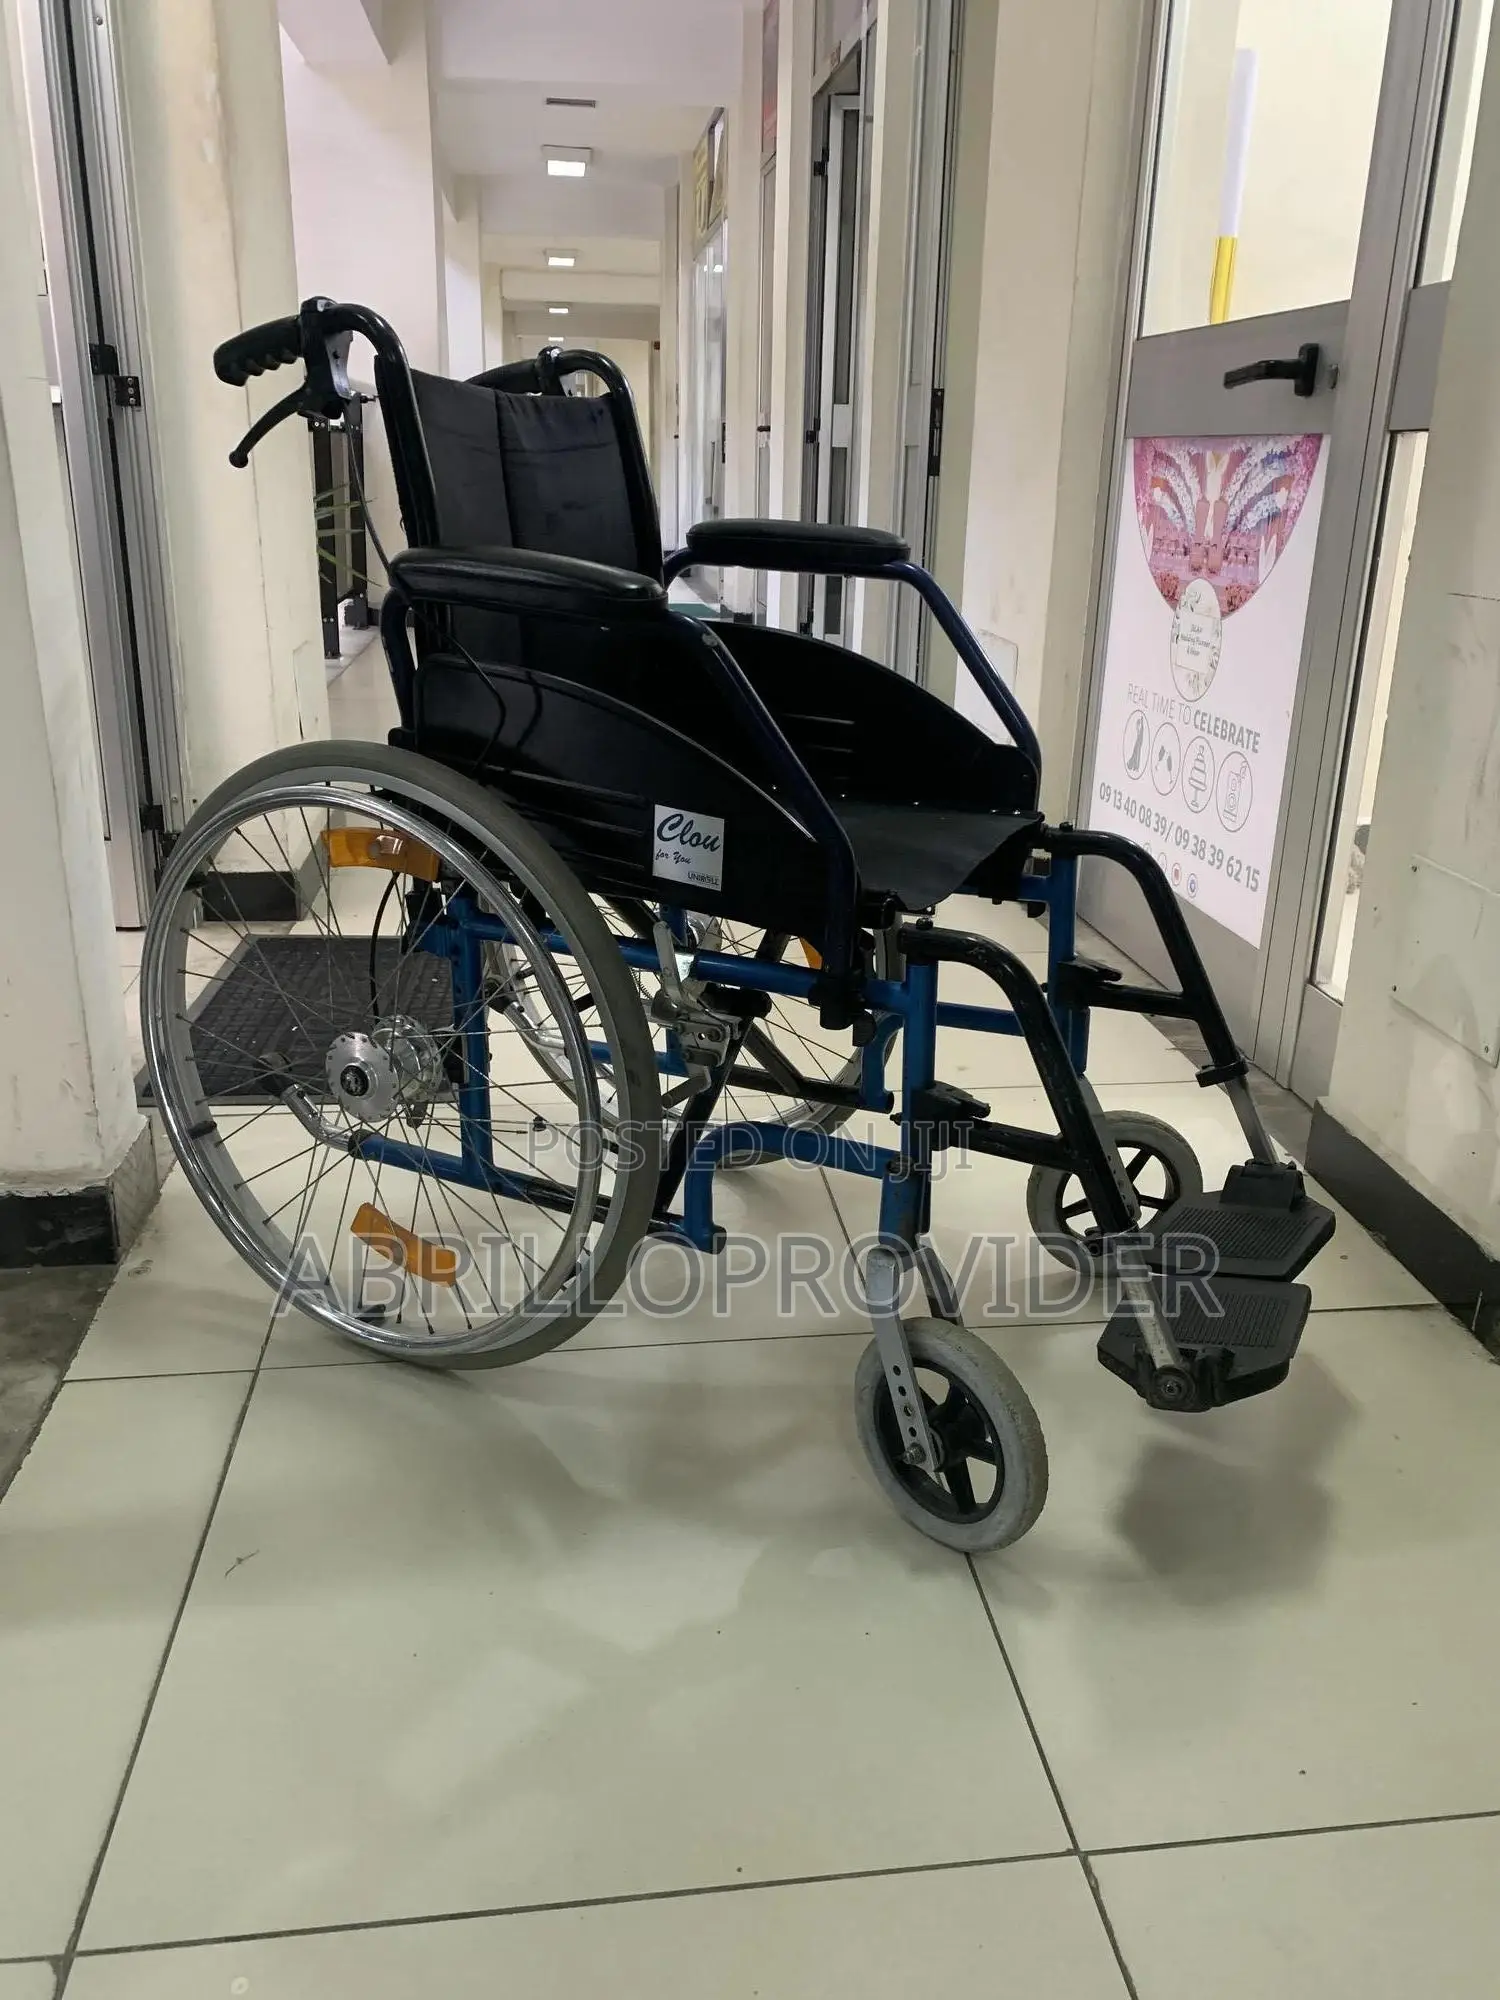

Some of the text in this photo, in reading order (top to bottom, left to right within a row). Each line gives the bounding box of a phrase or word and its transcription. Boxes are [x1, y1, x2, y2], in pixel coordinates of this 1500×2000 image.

[1127, 683, 1261, 754] REAL TIME TO CELEBRATE
[655, 848, 692, 865] for You
[656, 813, 721, 852] Clou
[1099, 782, 1112, 803] 09
[1113, 789, 1123, 810] 13
[1124, 796, 1137, 819] 40
[1138, 804, 1152, 828] 08
[1175, 825, 1190, 850] 09
[1191, 835, 1206, 861] 38
[1207, 844, 1224, 870] 39
[1226, 855, 1243, 883] 62
[1245, 865, 1260, 892] 15
